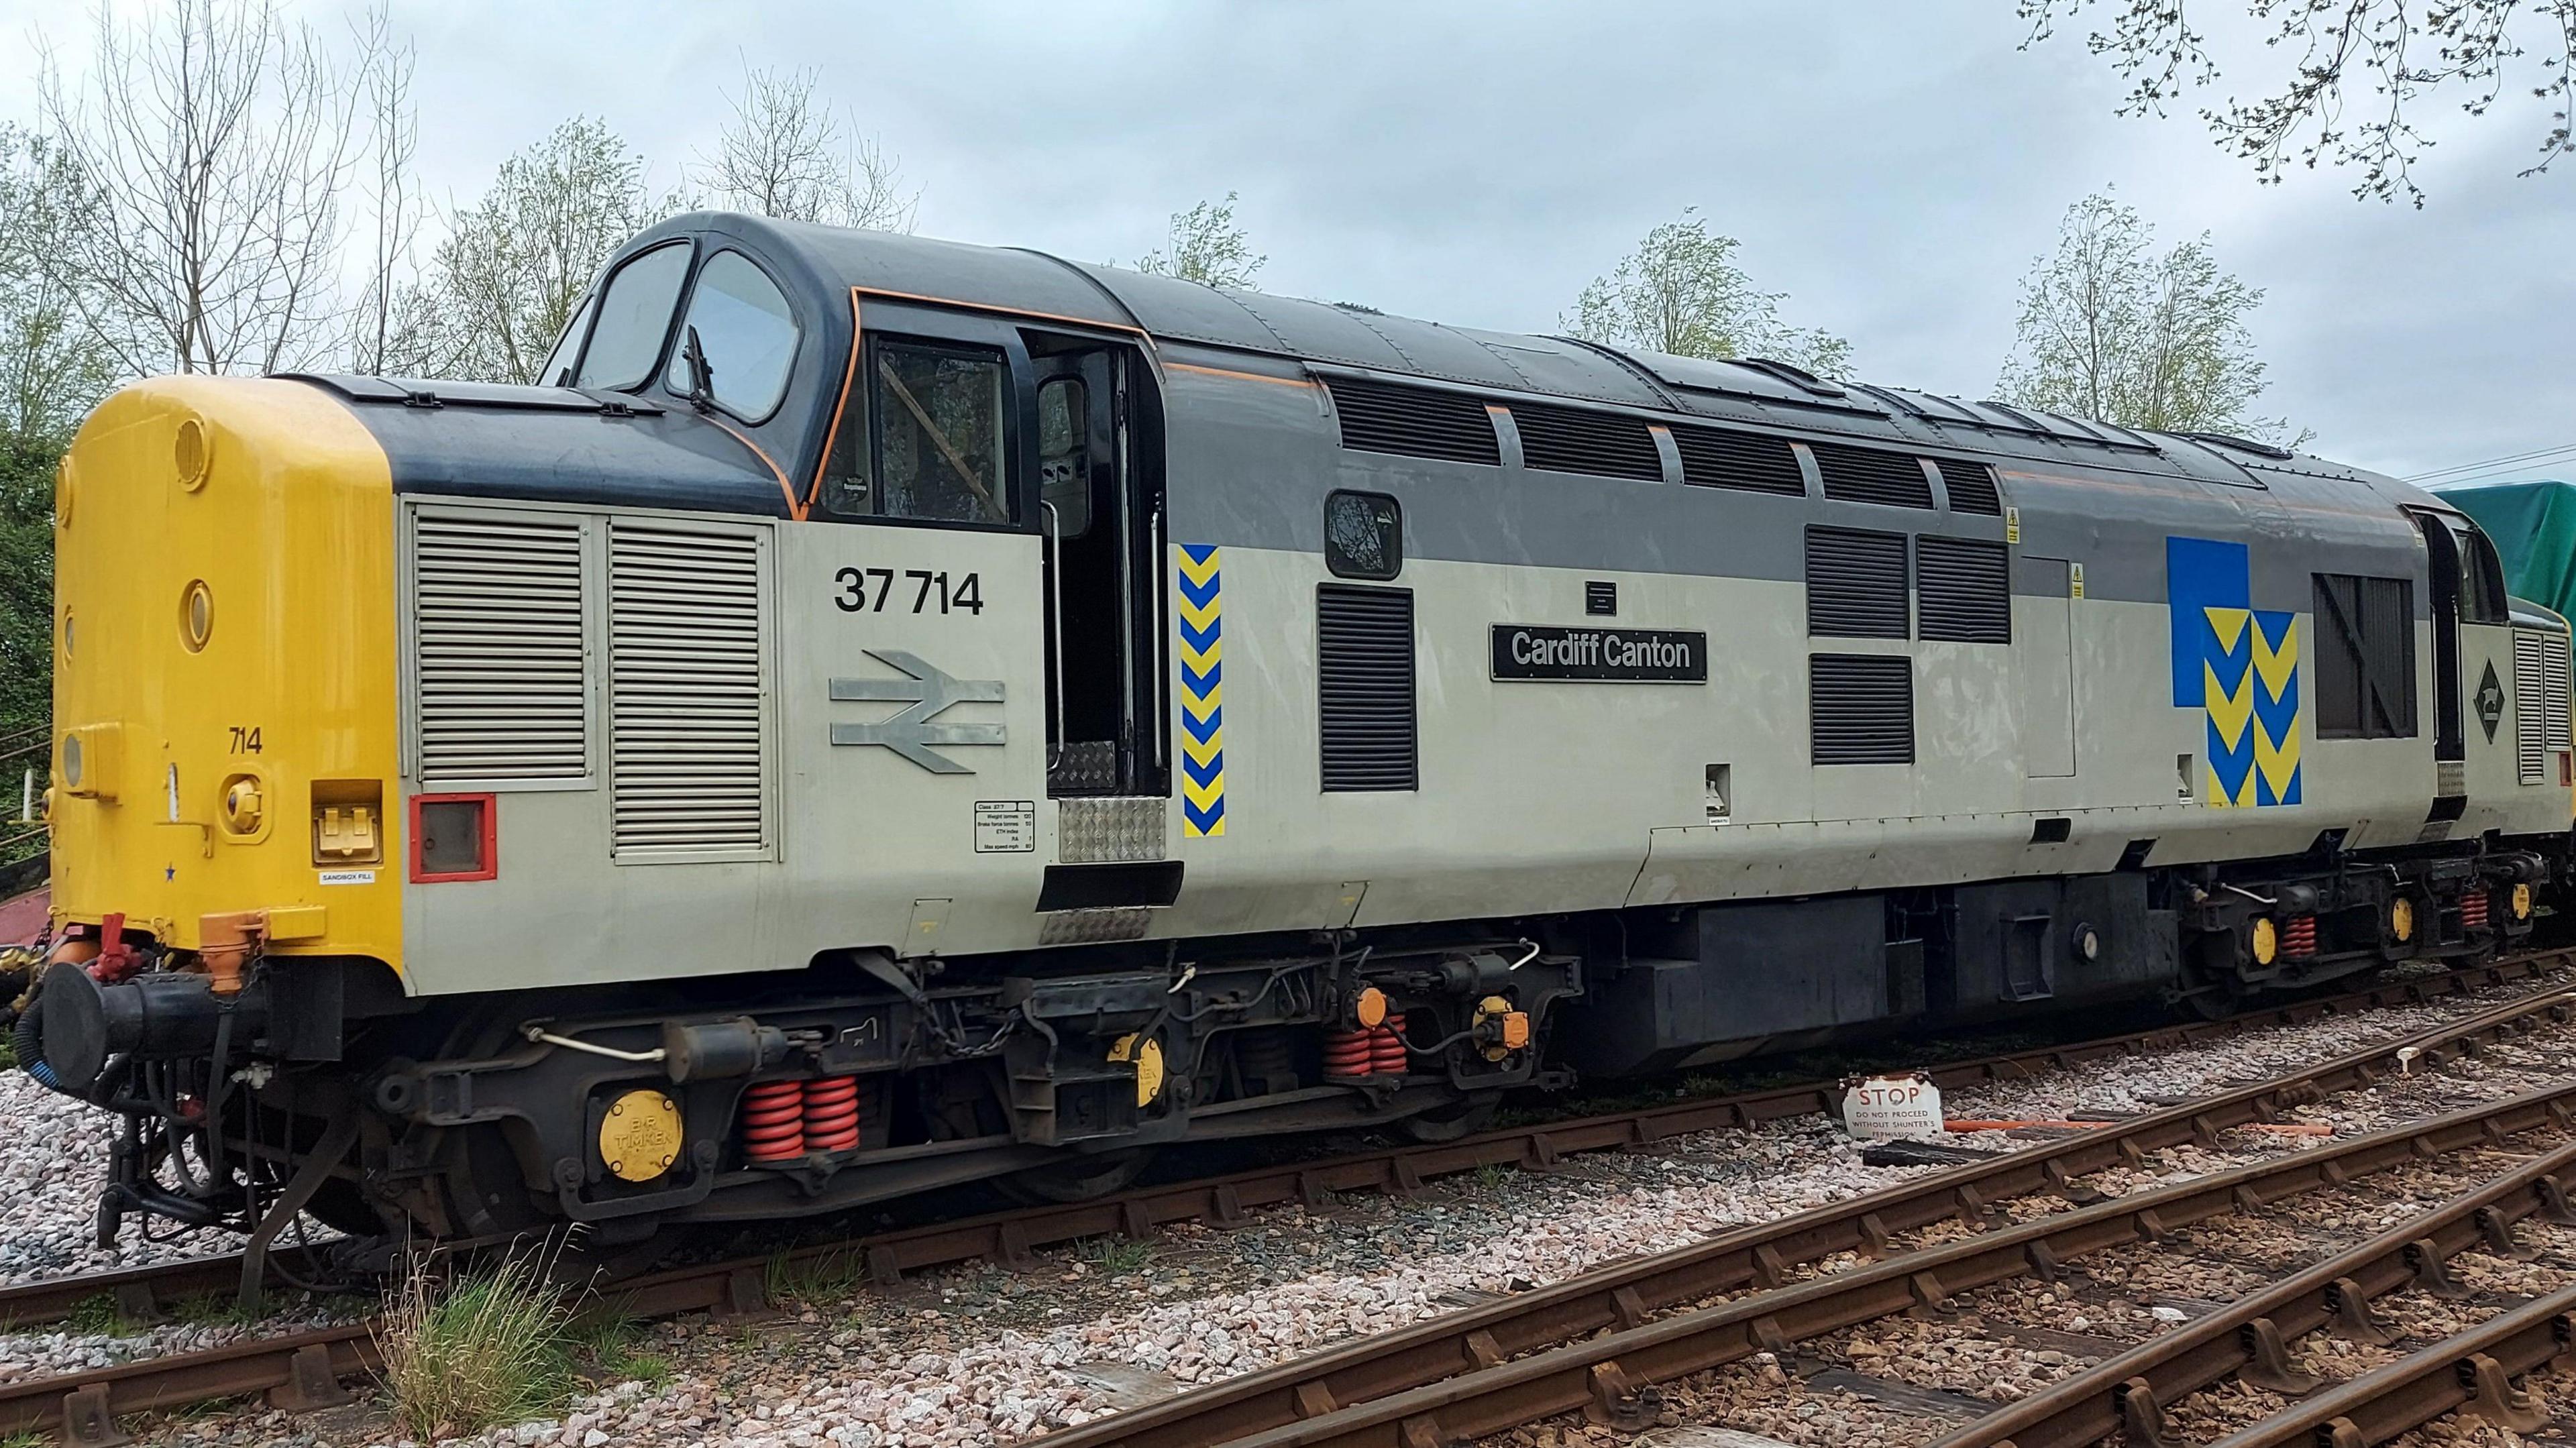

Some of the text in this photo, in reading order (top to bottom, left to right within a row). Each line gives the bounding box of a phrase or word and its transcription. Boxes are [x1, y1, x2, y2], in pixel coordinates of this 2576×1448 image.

[835, 567, 983, 615] 37 714
[1512, 632, 1690, 667] Cardiff Canton
[229, 726, 262, 755] 714
[1859, 1087, 1919, 1106] STOP
[1892, 1110, 1928, 1118] PROCEED
